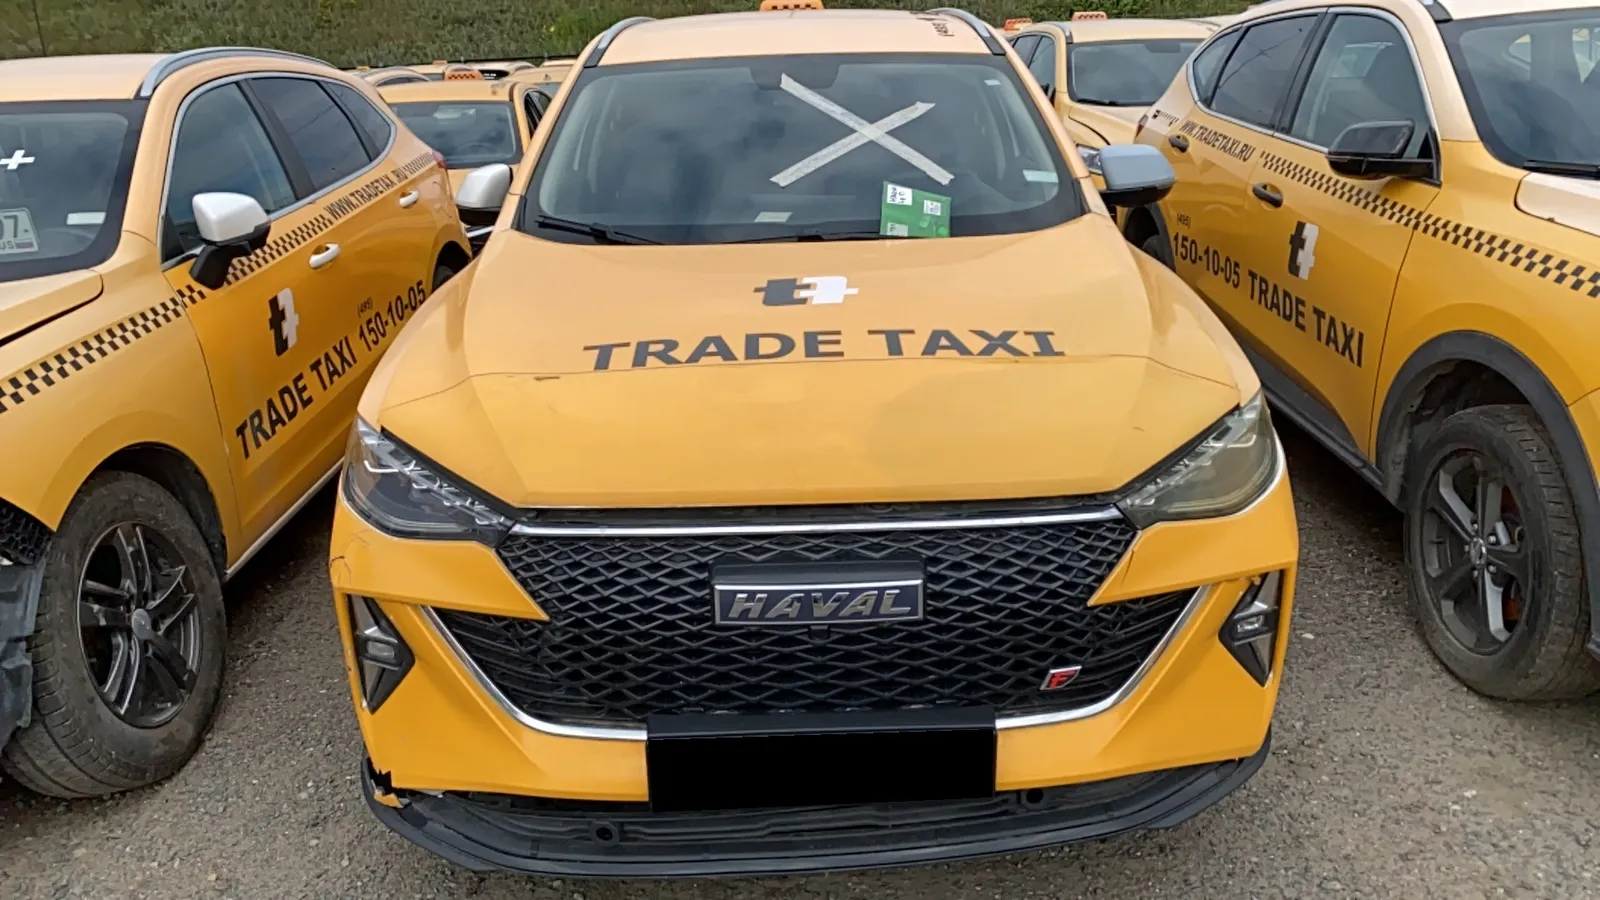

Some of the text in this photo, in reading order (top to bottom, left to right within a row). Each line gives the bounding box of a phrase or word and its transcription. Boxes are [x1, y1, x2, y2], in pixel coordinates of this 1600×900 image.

[1176, 213, 1192, 230] (495)
[0, 240, 15, 250] US
[1173, 232, 1365, 369] 150-10-05 TRADE TAXI
[583, 329, 1066, 371] TRADE TAXI
[235, 279, 426, 460] TRADE TAXI 150-10-05
[727, 588, 912, 618] HAVAL
